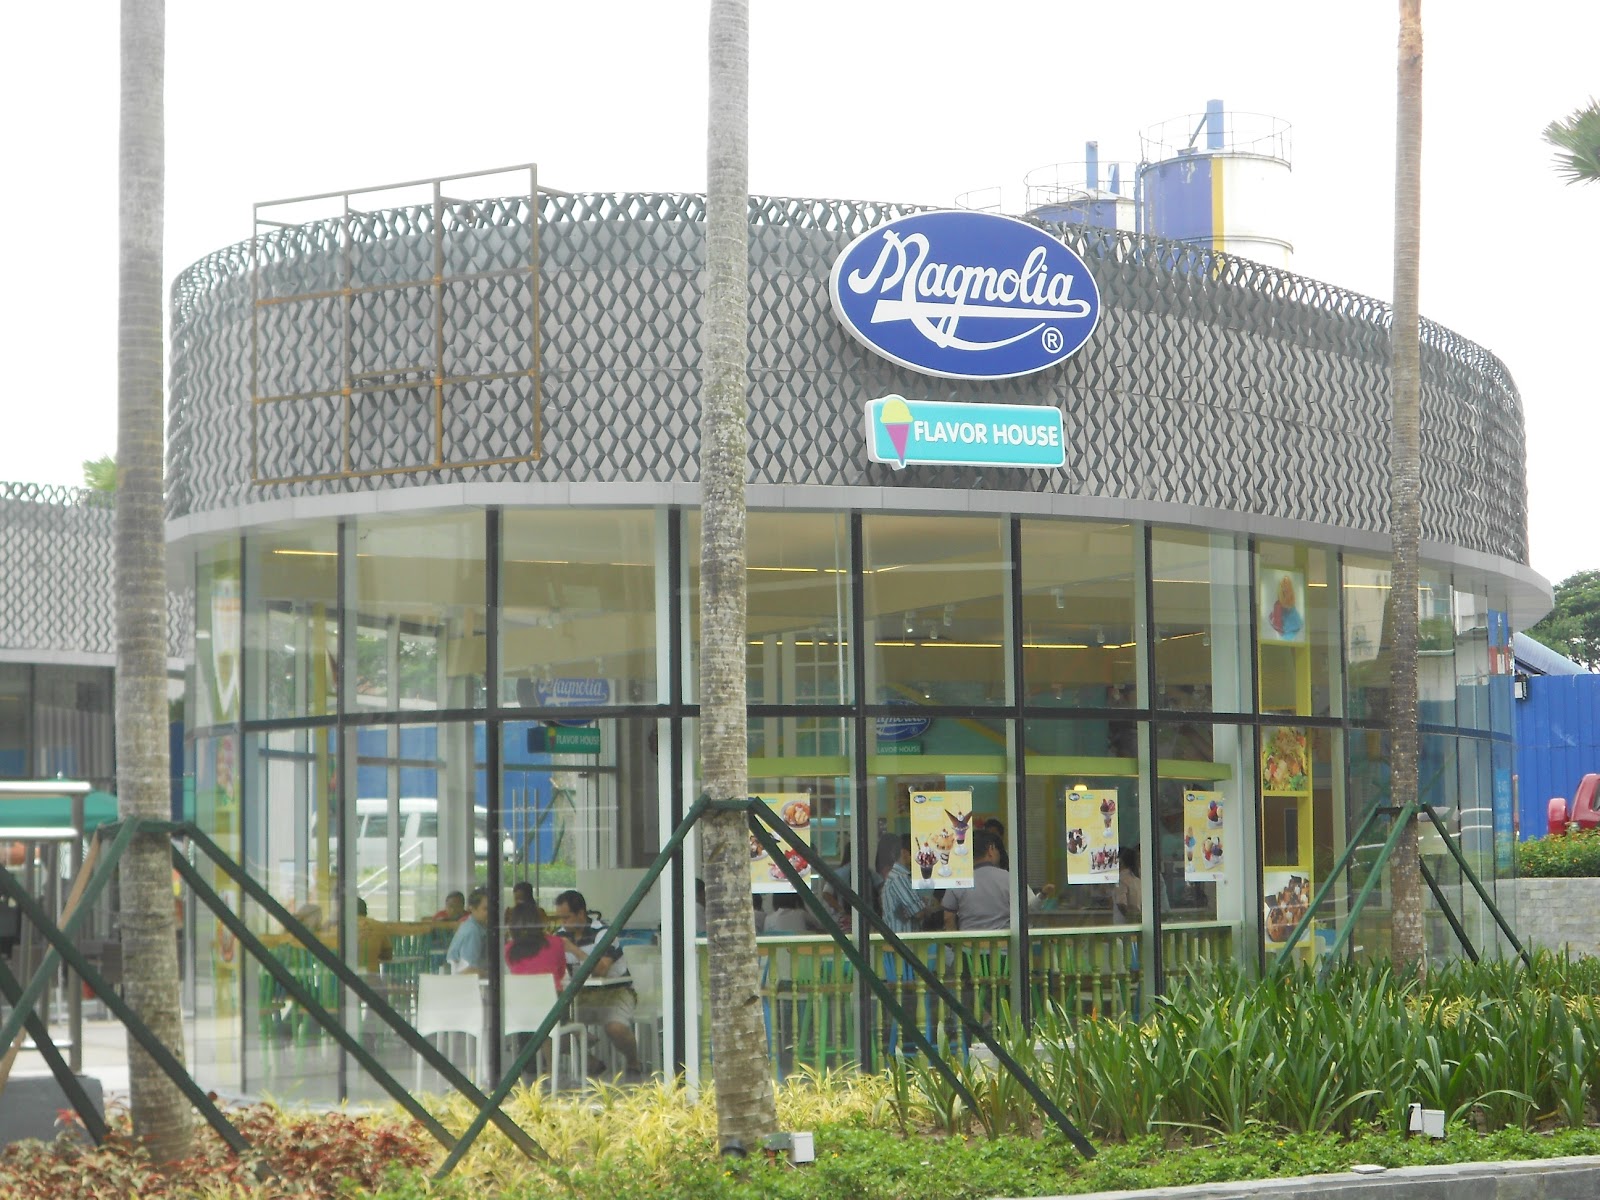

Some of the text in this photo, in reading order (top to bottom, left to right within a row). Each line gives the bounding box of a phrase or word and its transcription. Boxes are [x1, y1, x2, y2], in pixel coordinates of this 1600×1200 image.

[848, 229, 1091, 350] Magnolia
[914, 420, 1059, 447] FLAVOR HOUSE
[556, 735, 579, 745] FLAVOR
